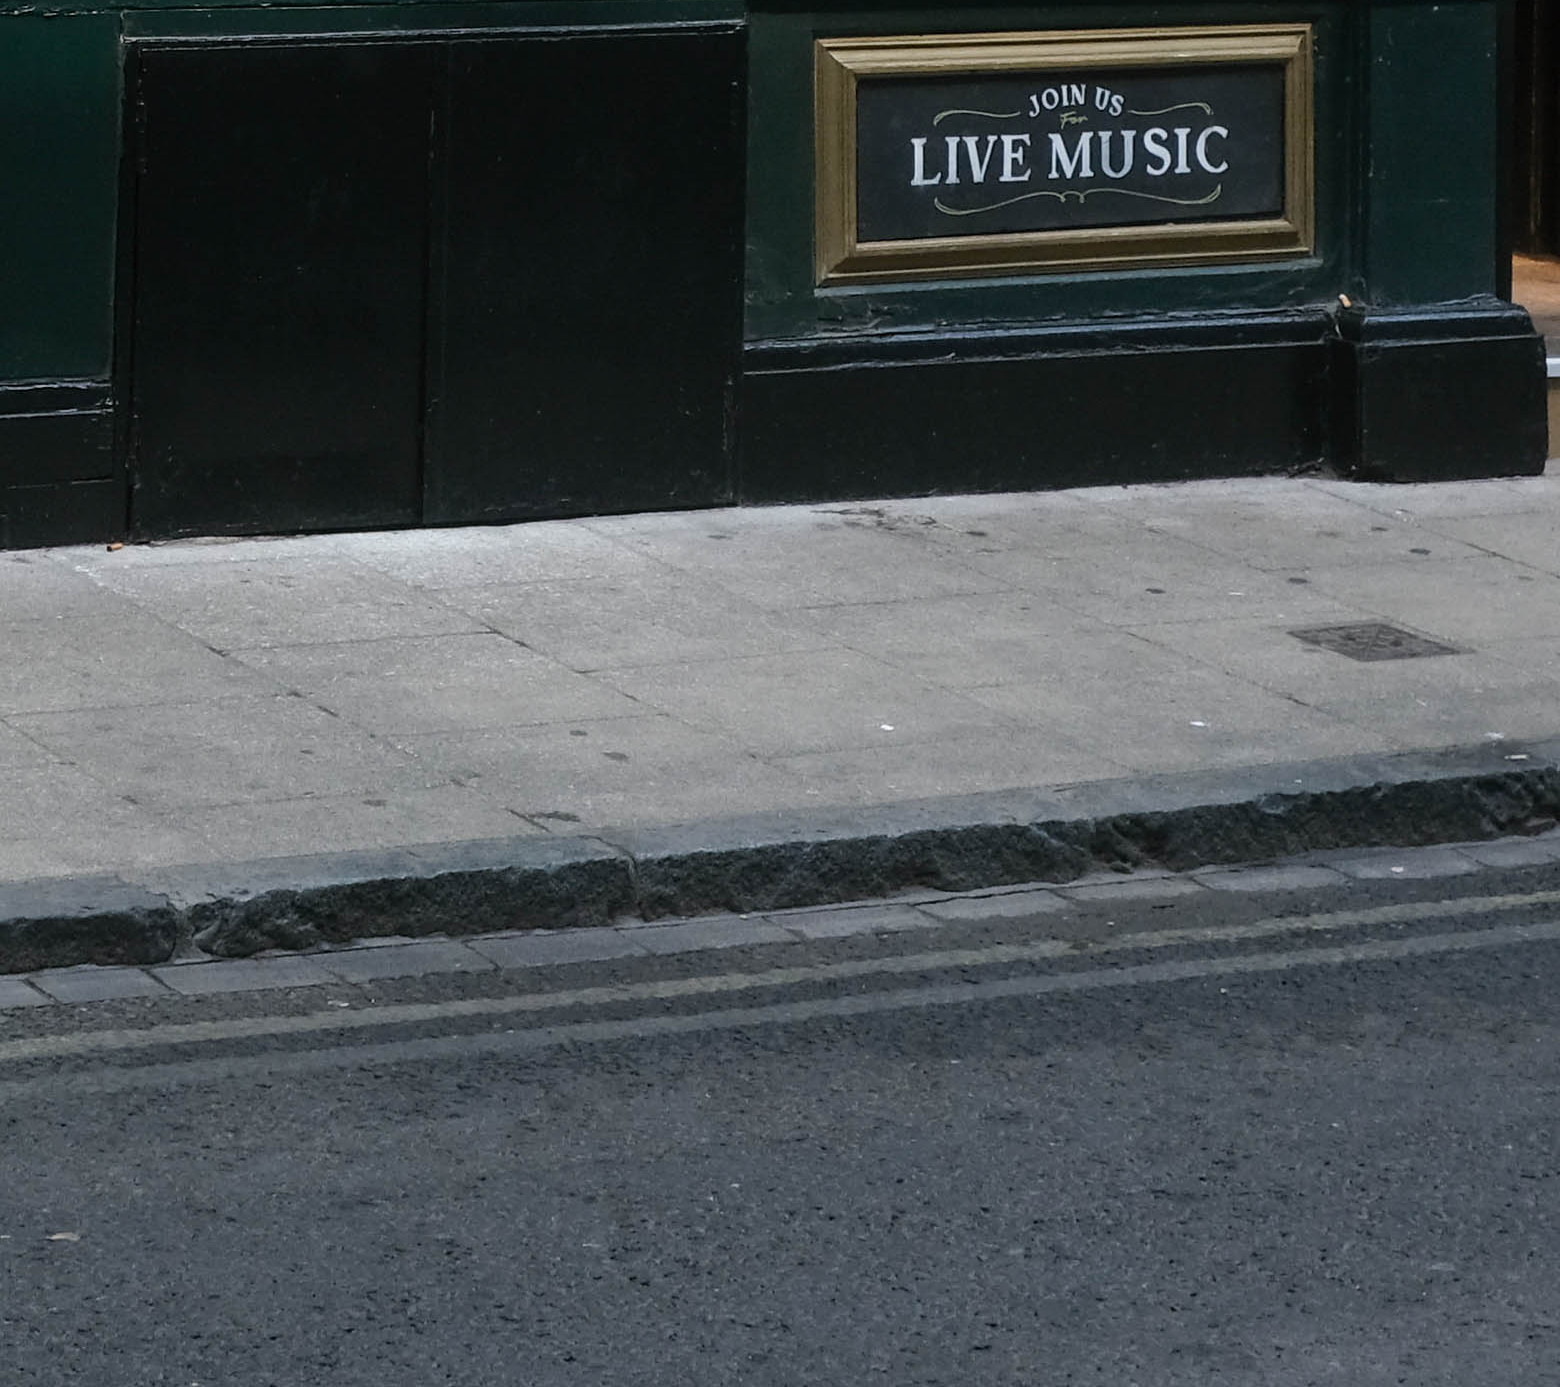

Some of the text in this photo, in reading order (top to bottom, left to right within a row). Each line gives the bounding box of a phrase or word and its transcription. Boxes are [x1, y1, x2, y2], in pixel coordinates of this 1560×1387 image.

[1028, 83, 1125, 119] JOIN US
[910, 125, 1231, 188] LIVE MUSIC
